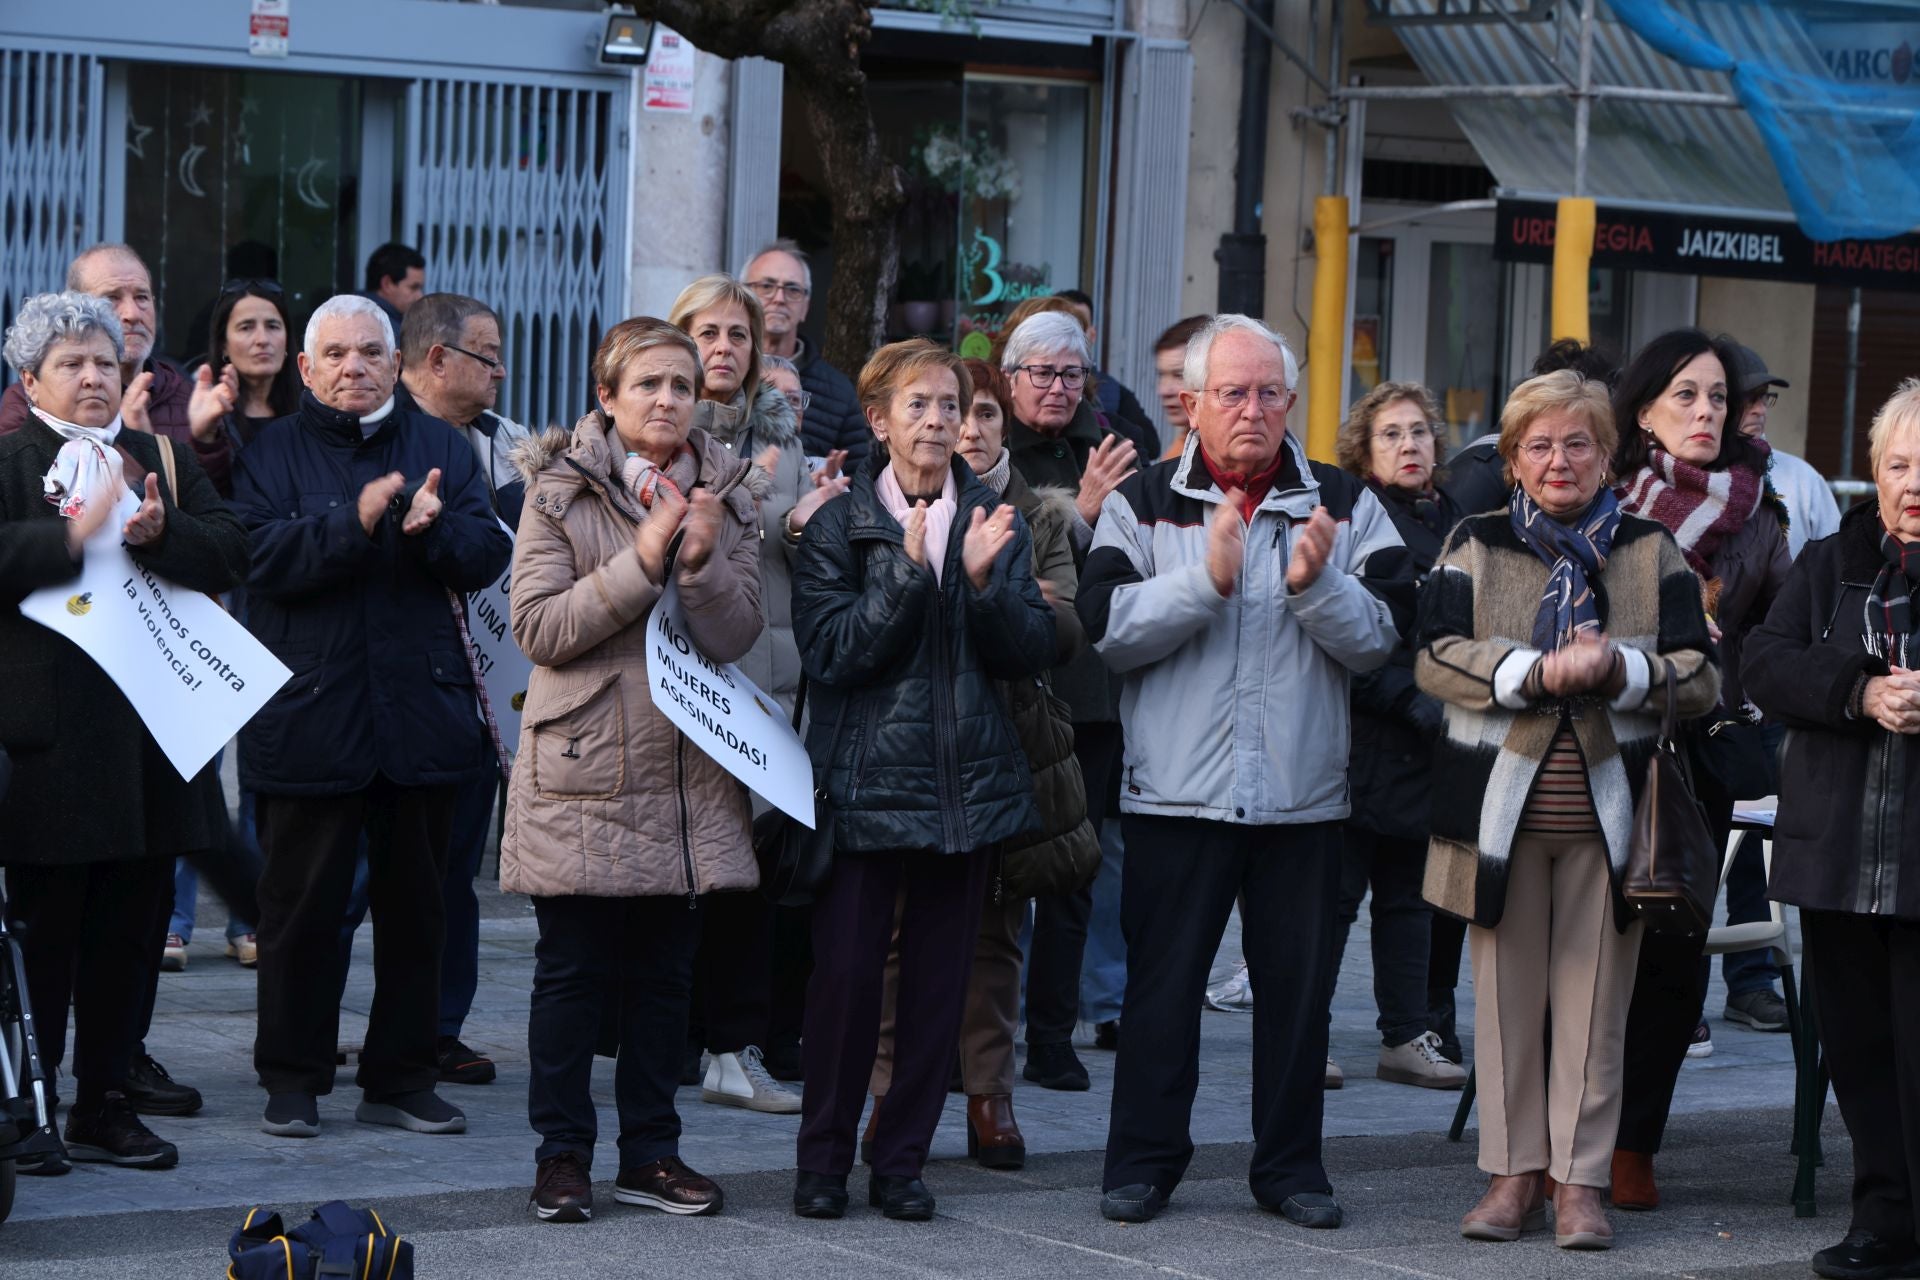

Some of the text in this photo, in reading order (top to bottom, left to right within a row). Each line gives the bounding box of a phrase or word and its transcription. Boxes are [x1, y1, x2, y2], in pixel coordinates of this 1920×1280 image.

[1513, 217, 1654, 253] URDEGIA
[1677, 228, 1784, 263] JAIZKIBEL
[123, 577, 203, 692] la violencia!
[477, 597, 507, 642] UNA
[658, 610, 690, 656] ¡NO
[189, 639, 246, 693] contra
[657, 645, 732, 716] MUJERES
[660, 676, 767, 771] ASESINADAS!
